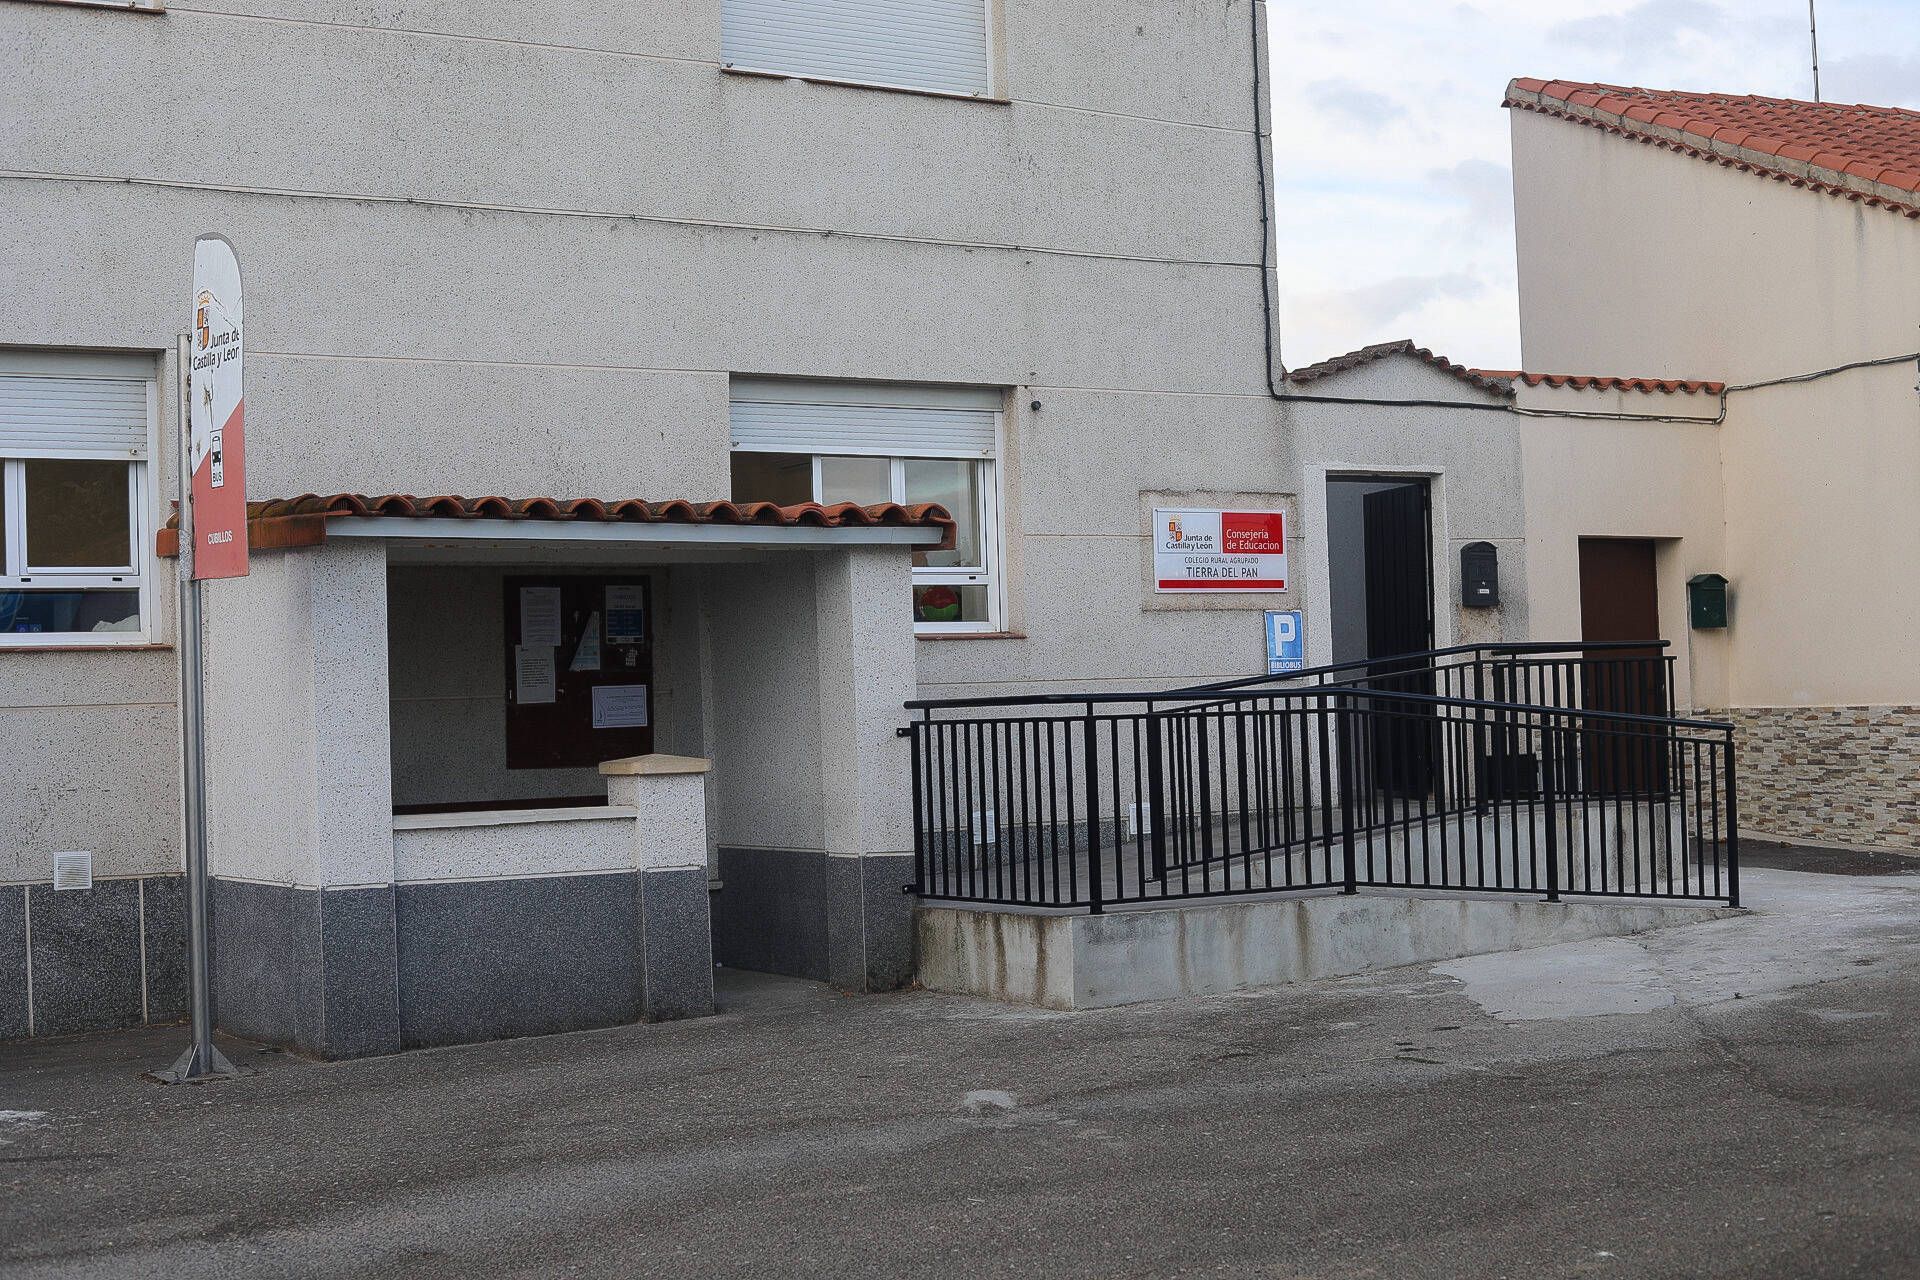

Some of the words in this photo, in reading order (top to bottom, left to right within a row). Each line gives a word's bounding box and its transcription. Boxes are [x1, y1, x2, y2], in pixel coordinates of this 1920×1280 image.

[210, 331, 230, 349] Junta
[193, 351, 216, 371] Castilla
[216, 351, 222, 369] y
[212, 471, 223, 483] BUS
[207, 530, 233, 545] CUBILLOS
[1184, 534, 1203, 542] Junta
[1203, 534, 1213, 542] de
[1226, 528, 1269, 541] Consejería
[1165, 541, 1190, 550] Castilla
[1226, 540, 1237, 550] de
[1184, 556, 1209, 564] COLEGIO
[1210, 556, 1228, 564] RURAL
[1186, 566, 1219, 578] TIERRA
[1221, 567, 1239, 578] DEL
[1241, 567, 1258, 578] PAN
[1273, 614, 1296, 657] P
[1270, 661, 1302, 669] BIBLIOBUS
